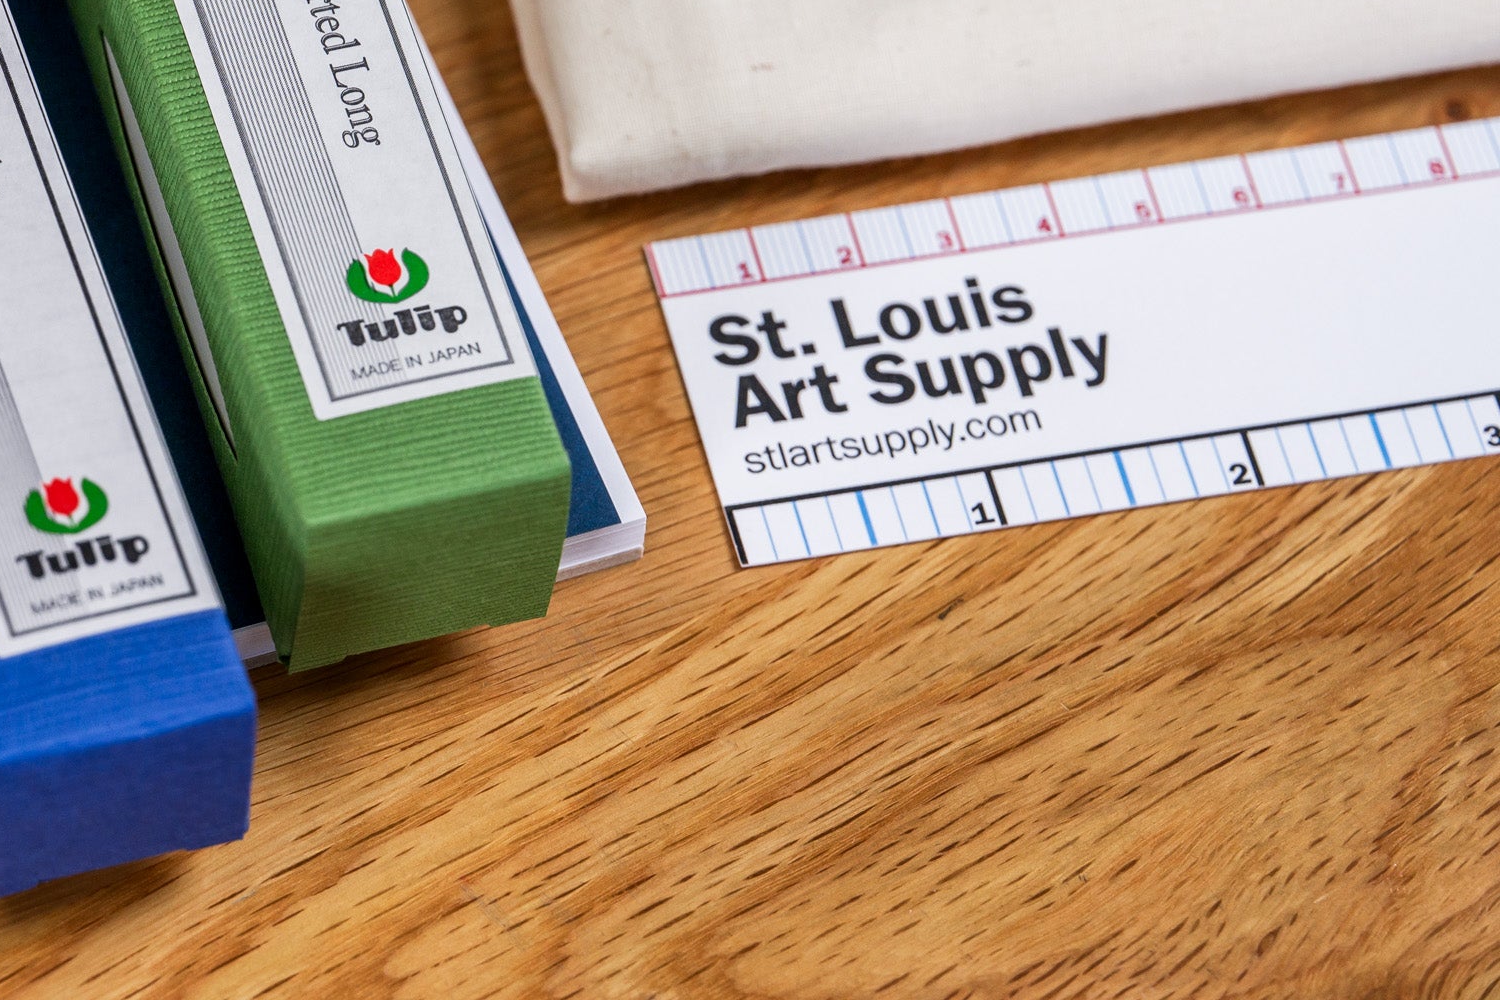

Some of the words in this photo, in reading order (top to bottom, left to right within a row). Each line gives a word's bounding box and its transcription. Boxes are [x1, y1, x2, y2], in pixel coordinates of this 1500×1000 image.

[330, 56, 381, 148] Long
[837, 247, 852, 264] 2
[1038, 217, 1052, 233] 4
[337, 305, 467, 346] Tulip
[709, 311, 816, 366] St.
[830, 277, 1033, 348] Louis
[351, 359, 402, 379] MADE
[405, 355, 422, 368] IN
[428, 342, 481, 364] JAPAN
[734, 364, 848, 428] Art
[865, 328, 1108, 404] Supply
[745, 409, 1042, 473] stlartsupply.com
[971, 502, 996, 526] 1
[1229, 463, 1252, 485] 2
[1484, 425, 1500, 446] 3
[16, 535, 149, 579] Tulip
